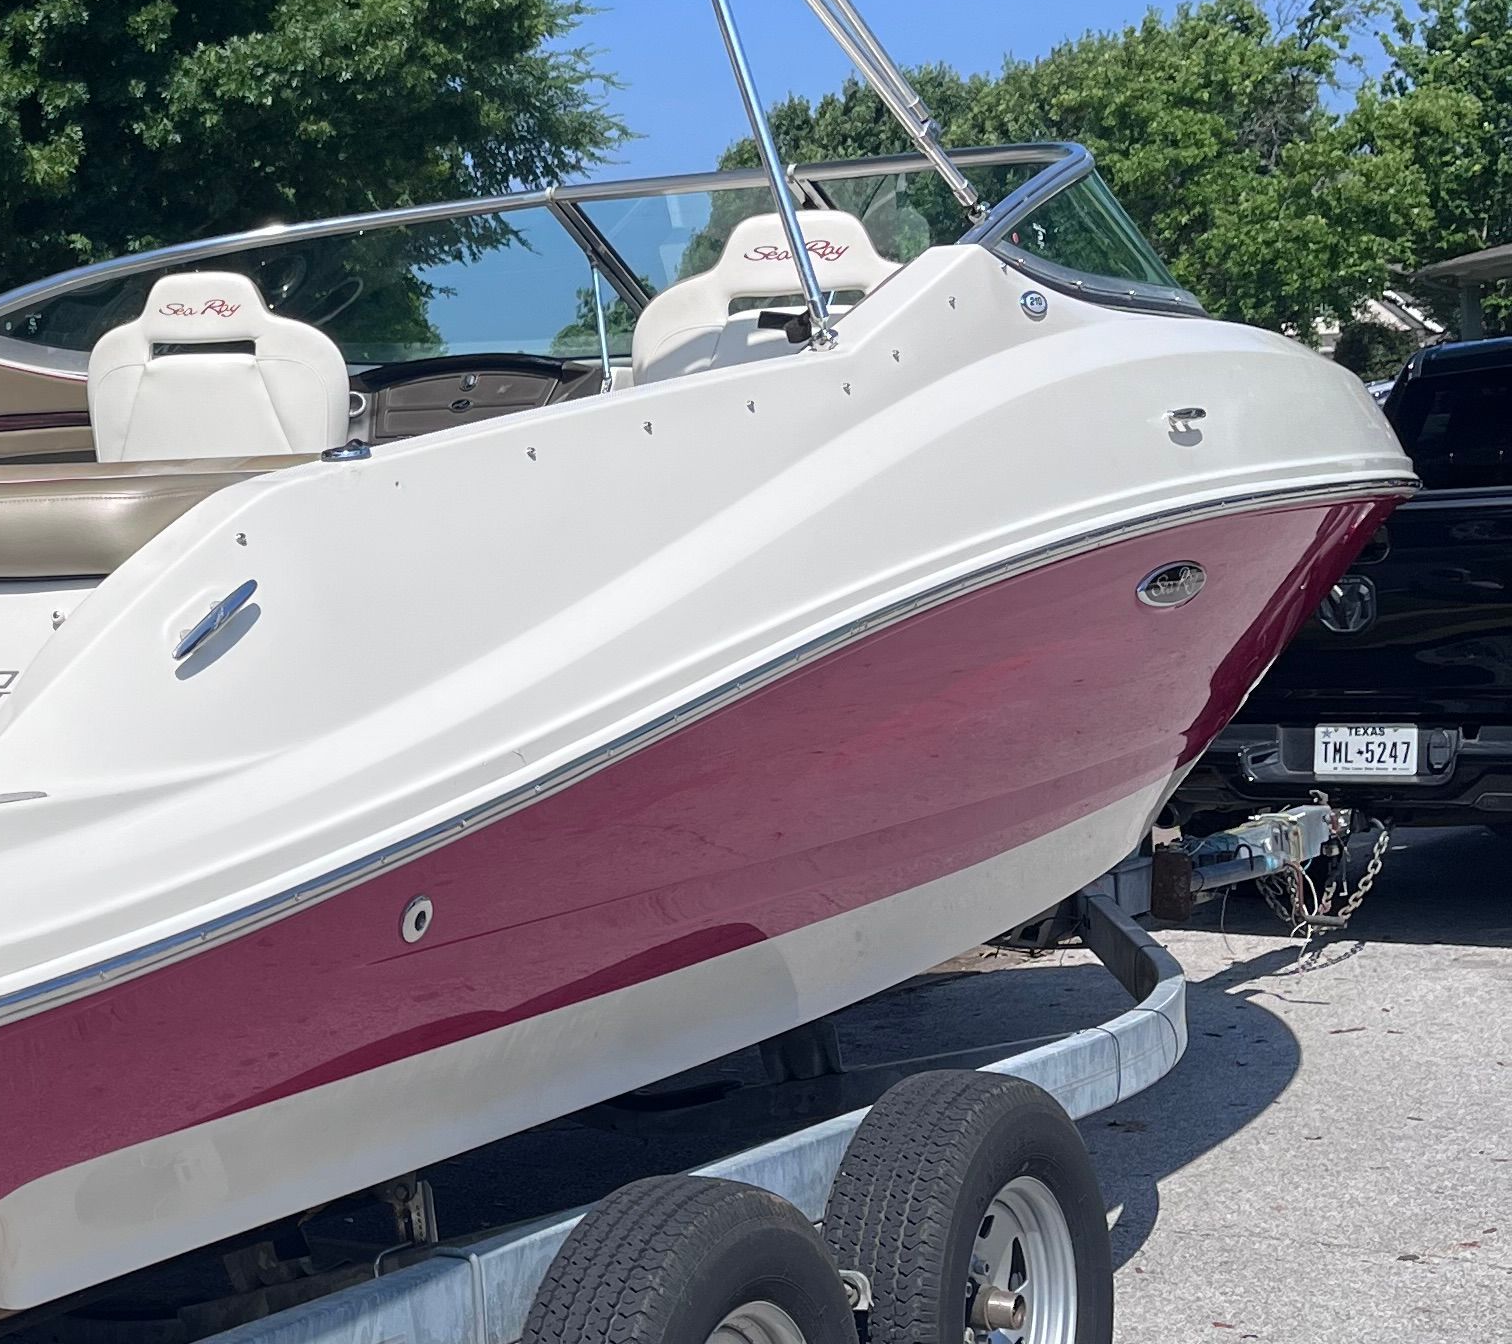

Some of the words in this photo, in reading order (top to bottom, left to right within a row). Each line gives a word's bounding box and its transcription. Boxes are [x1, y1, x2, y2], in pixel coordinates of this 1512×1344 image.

[743, 245, 793, 261] Sea
[805, 239, 850, 262] Ray
[158, 302, 198, 317] Sea
[200, 298, 242, 318] Ray
[1347, 726, 1386, 736] TEXAS
